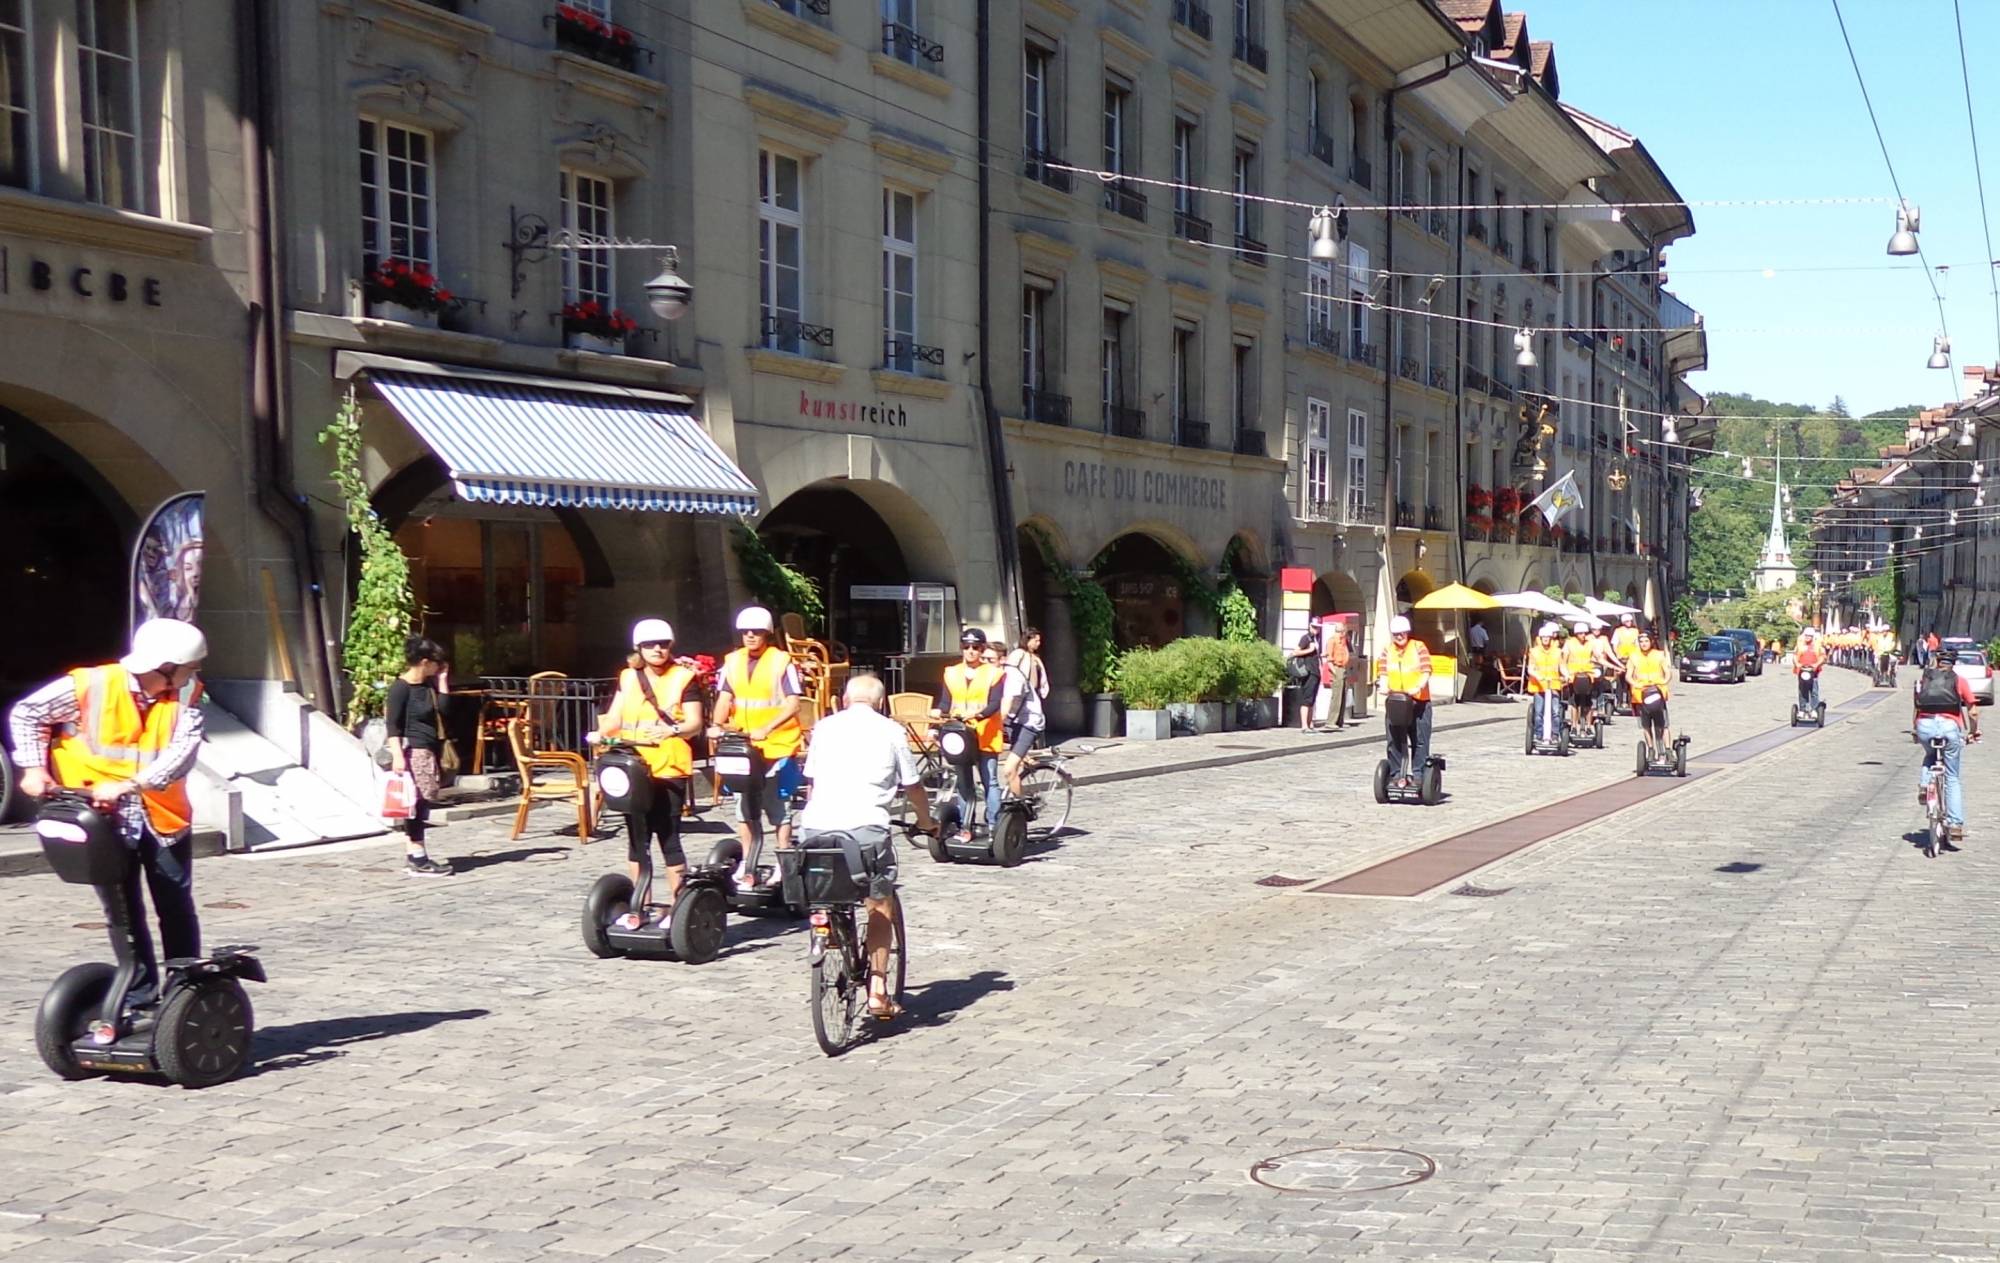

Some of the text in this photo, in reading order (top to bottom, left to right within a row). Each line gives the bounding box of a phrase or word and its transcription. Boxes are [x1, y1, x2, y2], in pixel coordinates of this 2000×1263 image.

[30, 259, 162, 307] BCBE
[799, 389, 907, 427] kunstreich
[1113, 467, 1137, 502] DU
[1143, 470, 1227, 510] COMMERCE
